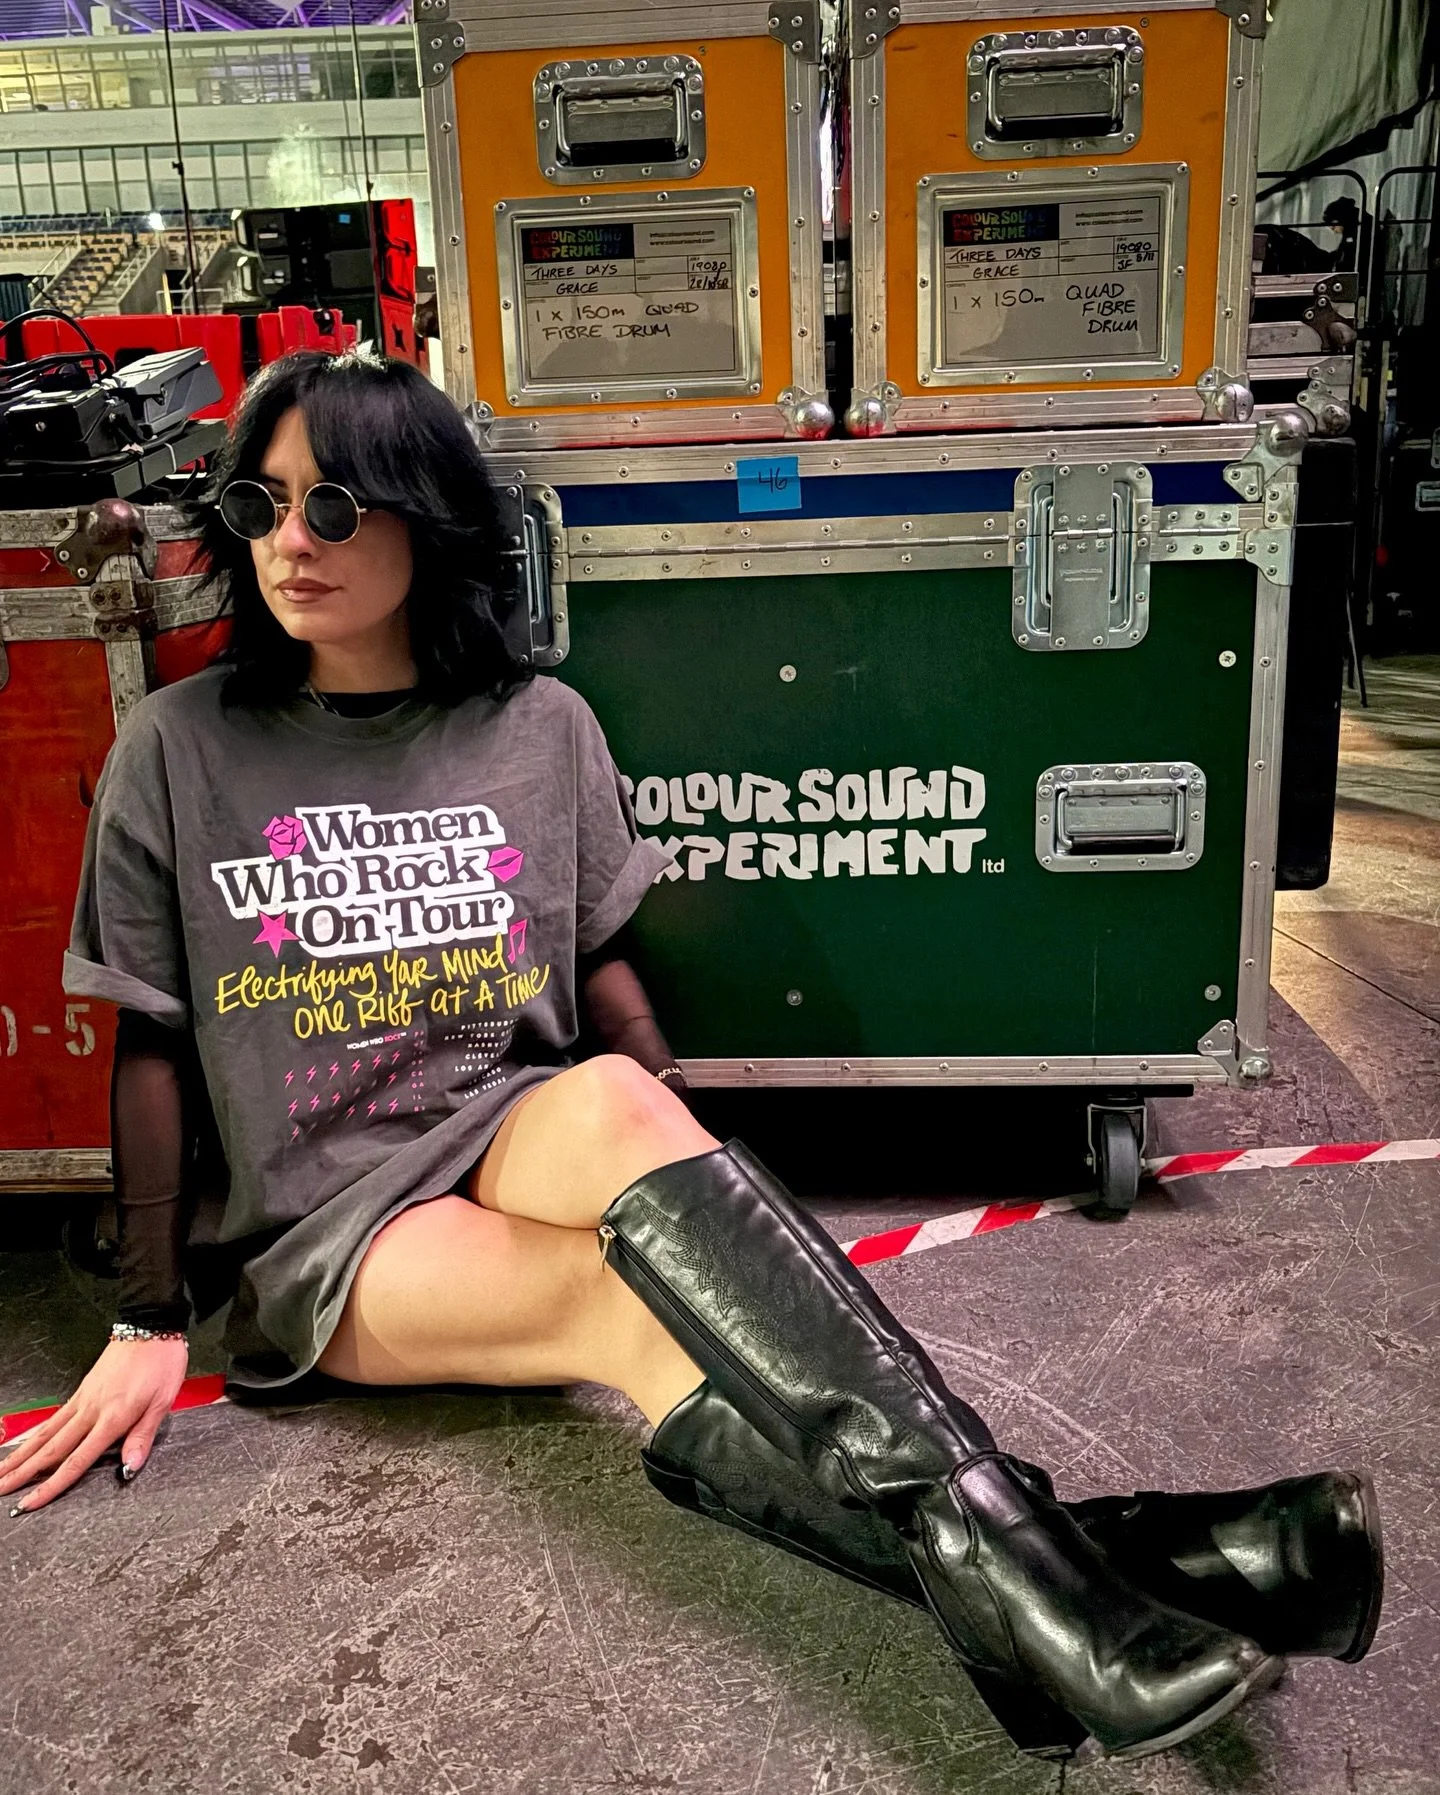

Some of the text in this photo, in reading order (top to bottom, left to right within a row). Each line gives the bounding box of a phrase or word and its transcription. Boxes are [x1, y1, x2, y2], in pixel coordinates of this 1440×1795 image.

[952, 224, 1046, 242] EXPERIME
[950, 246, 1042, 263] THREE DAYS
[531, 264, 618, 281] THREE DAYS
[973, 264, 1020, 279] GRACE
[556, 281, 599, 294] GRACE
[1065, 282, 1125, 300] QUAD
[1082, 299, 1136, 317] FIBRE
[613, 322, 672, 340] DRUM
[1087, 318, 1139, 334] DRUM
[757, 466, 788, 493] 46
[302, 809, 495, 851] Women
[644, 827, 1005, 884] XPERIMENT ltd
[218, 845, 484, 909] Who Rock
[301, 893, 506, 948] On Tour
[460, 1017, 519, 1031] PITTSBUR
